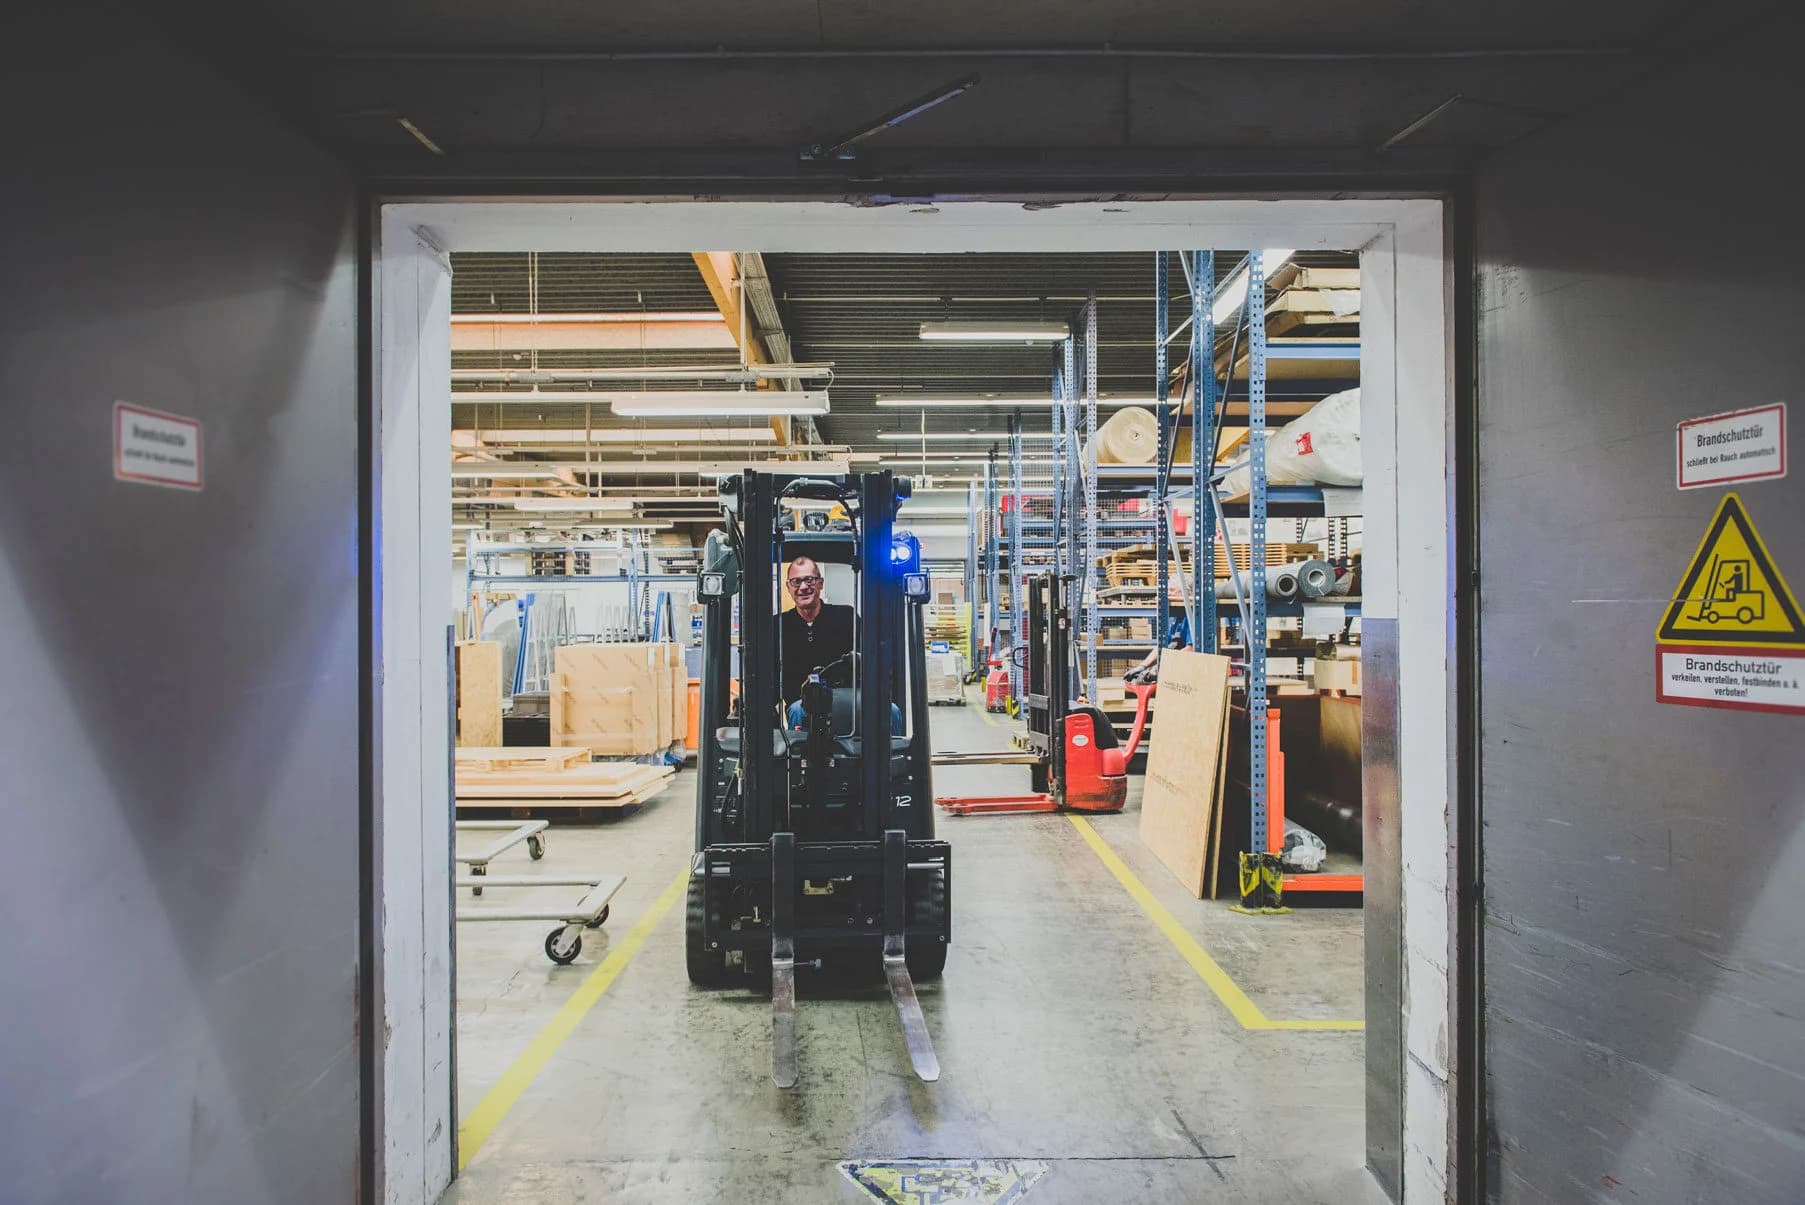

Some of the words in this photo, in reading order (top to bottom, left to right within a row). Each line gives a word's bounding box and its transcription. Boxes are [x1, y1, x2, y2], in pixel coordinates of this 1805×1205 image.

[1697, 425, 1764, 447] Brandschutztür
[1686, 456, 1708, 468] schließt
[1709, 455, 1719, 464] bei
[1720, 452, 1738, 463] Rauch
[1686, 658, 1782, 675] Brandschutztür
[895, 795, 912, 807] 12
